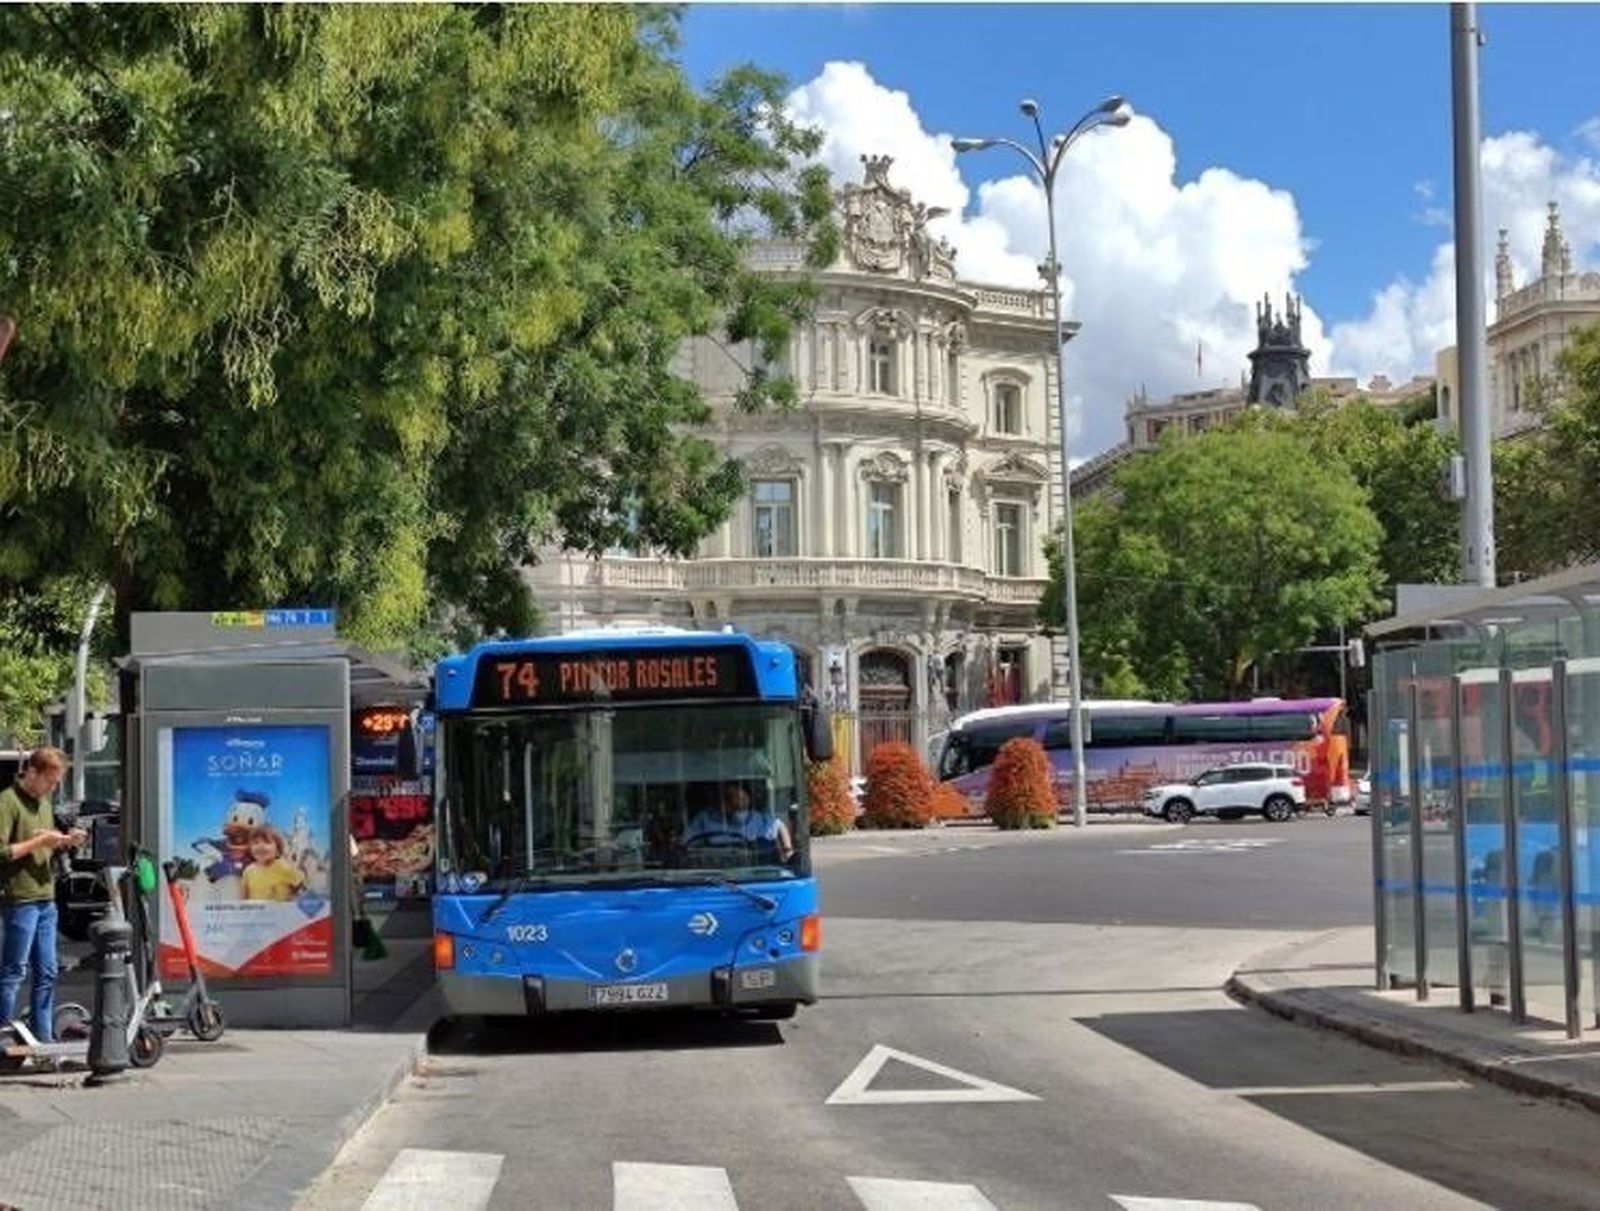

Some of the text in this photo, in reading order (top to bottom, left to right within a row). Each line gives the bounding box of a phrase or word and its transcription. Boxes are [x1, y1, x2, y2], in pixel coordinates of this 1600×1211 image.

[498, 656, 717, 699] 74 PINTOR ROSALES
[207, 751, 284, 772] SOÑAR
[506, 924, 548, 943] 1023
